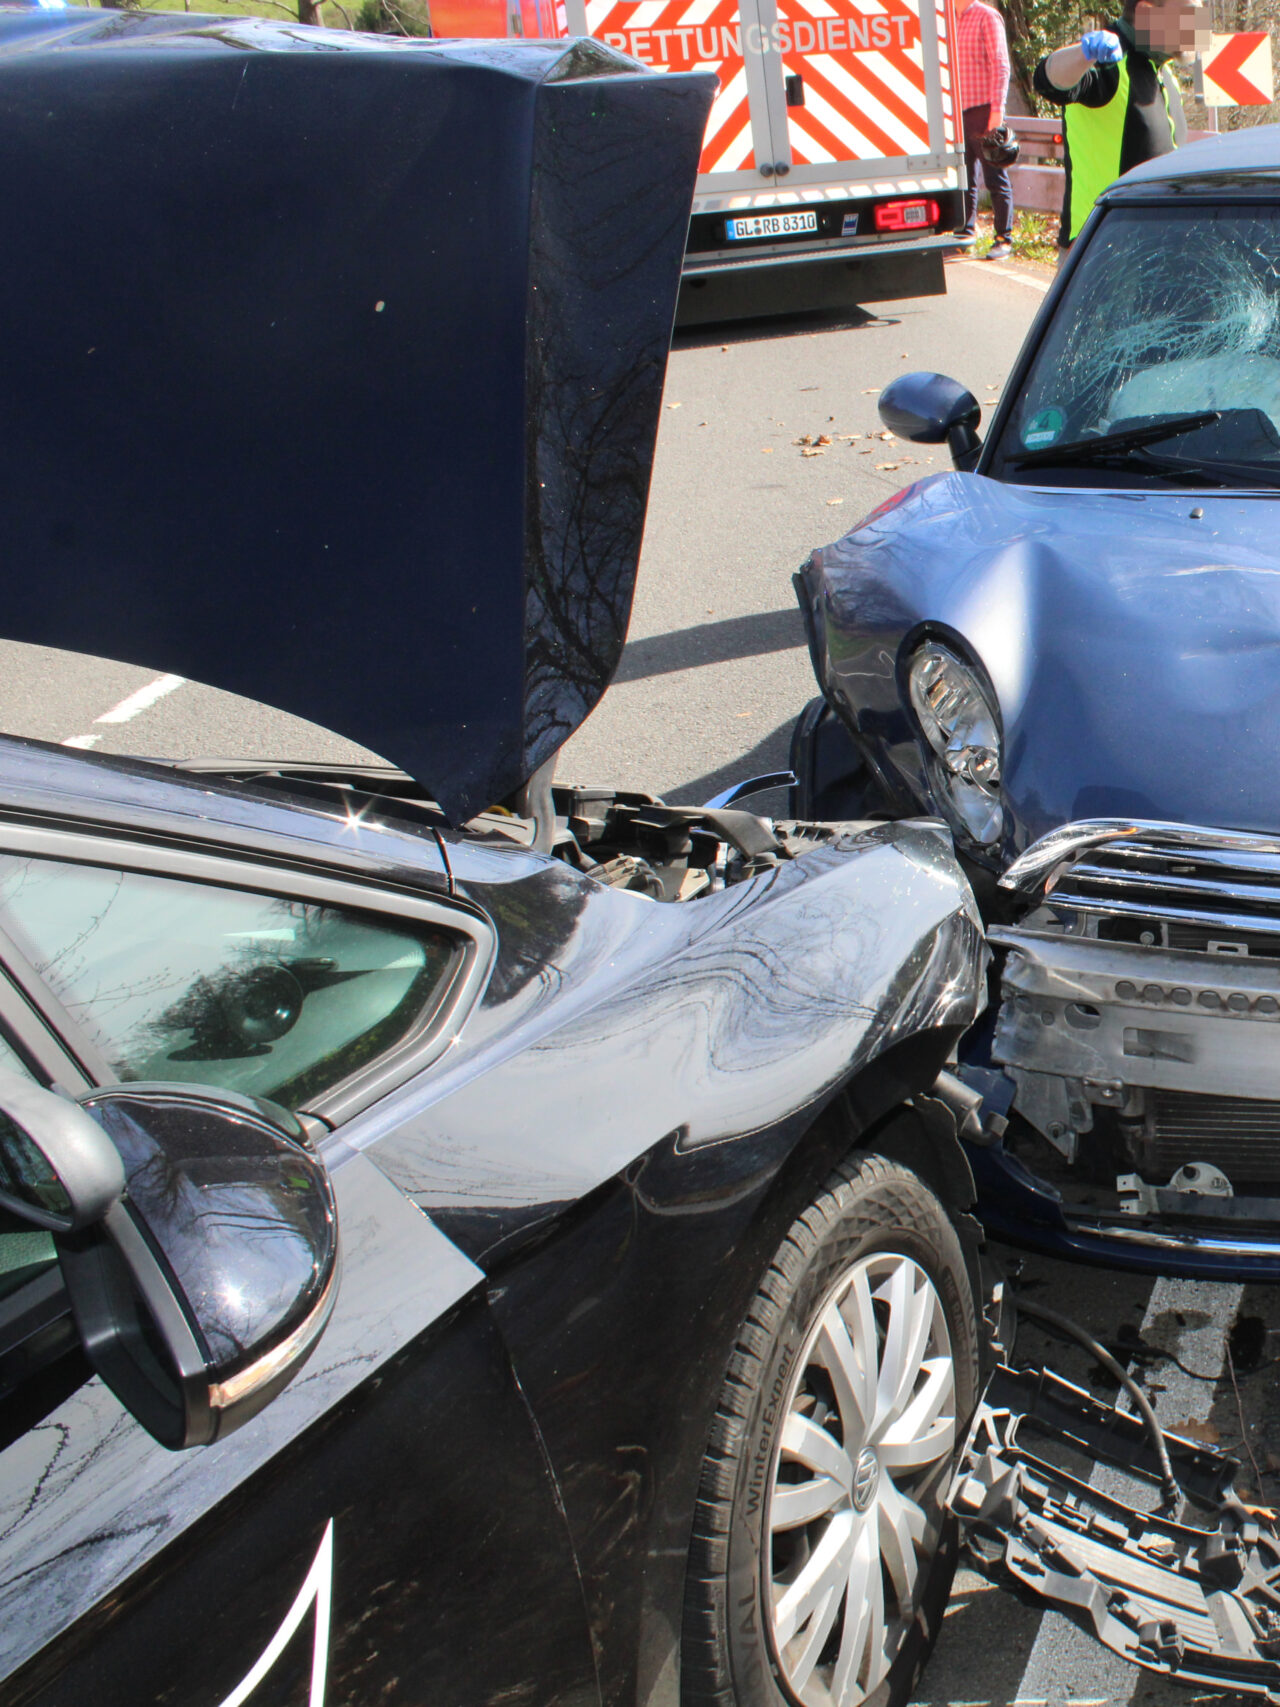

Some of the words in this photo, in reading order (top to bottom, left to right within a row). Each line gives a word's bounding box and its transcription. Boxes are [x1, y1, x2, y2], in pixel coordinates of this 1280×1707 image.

[604, 15, 909, 63] RETTUNGSDIENST
[735, 221, 753, 237] GL
[763, 218, 780, 234] RB
[783, 214, 816, 232] 8310
[1038, 412, 1050, 429] 4
[747, 1342, 795, 1516] WinterExpert
